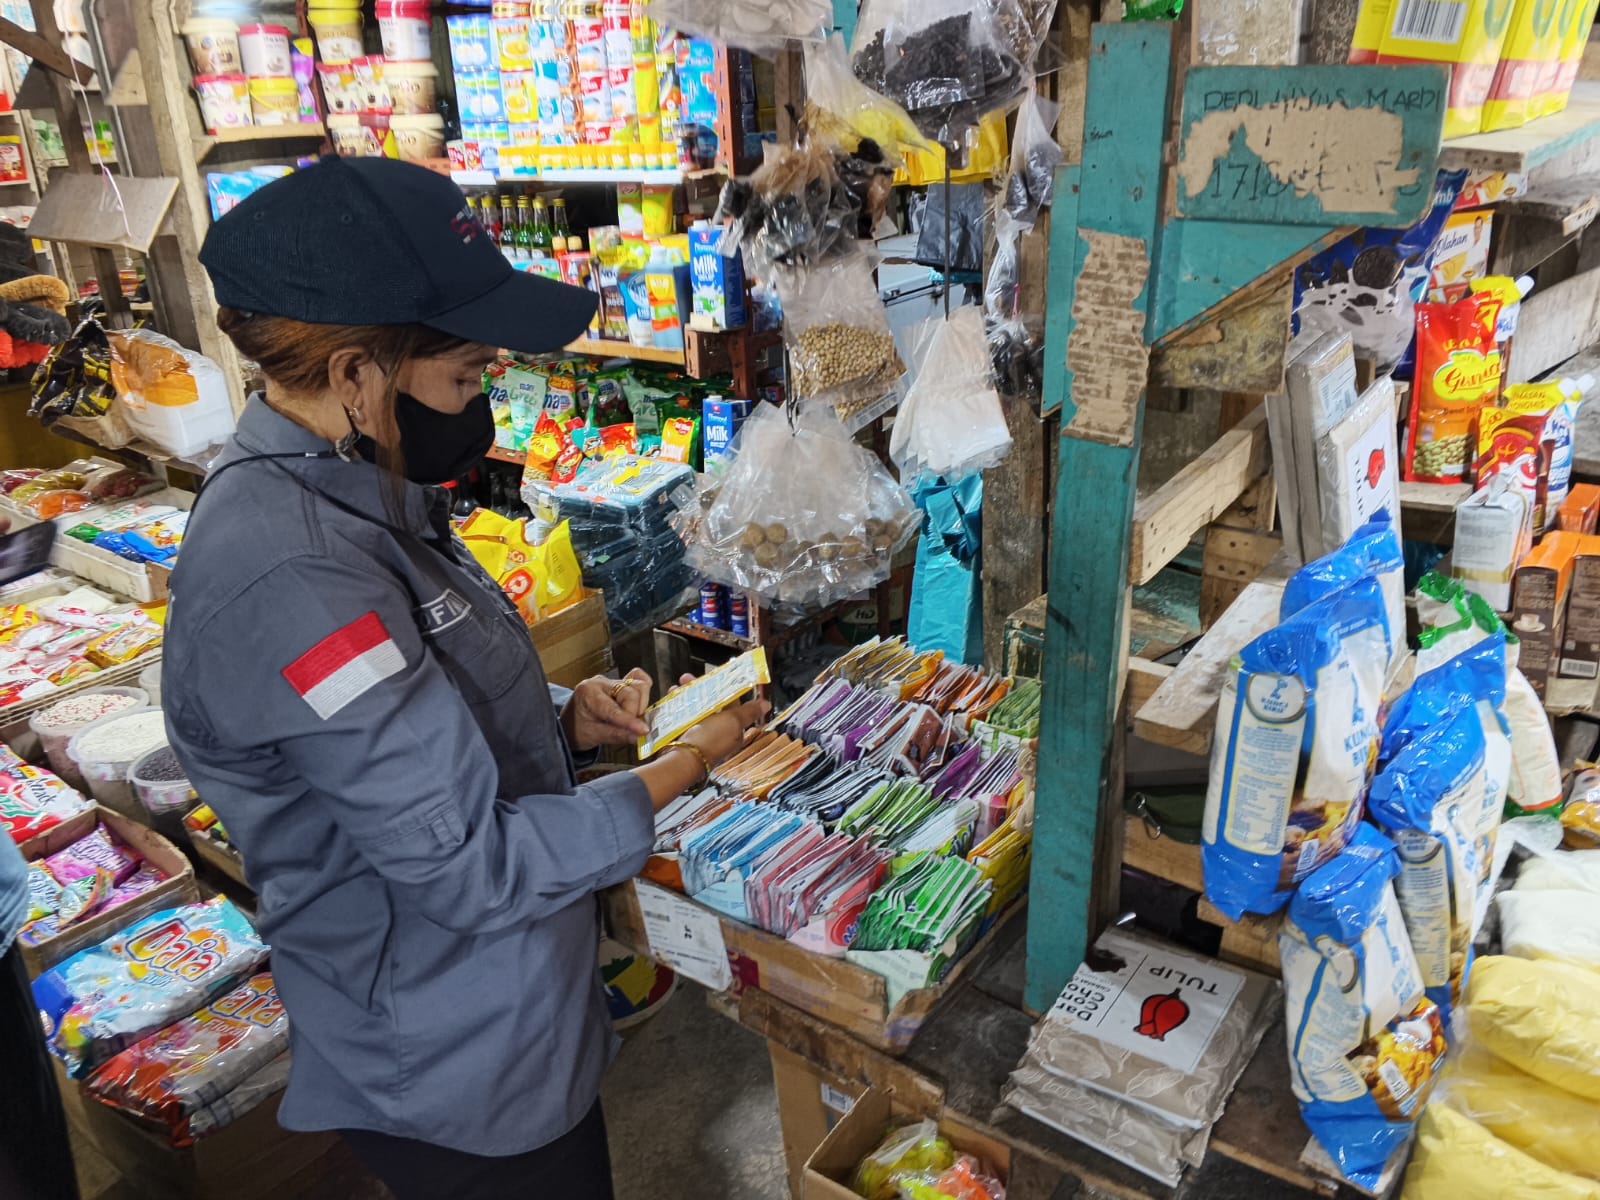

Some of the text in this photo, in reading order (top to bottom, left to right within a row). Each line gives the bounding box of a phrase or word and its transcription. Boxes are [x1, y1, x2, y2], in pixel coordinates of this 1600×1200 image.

[706, 425, 729, 442] Milk
[125, 917, 223, 982] Daia
[1149, 965, 1219, 996] TULIP
